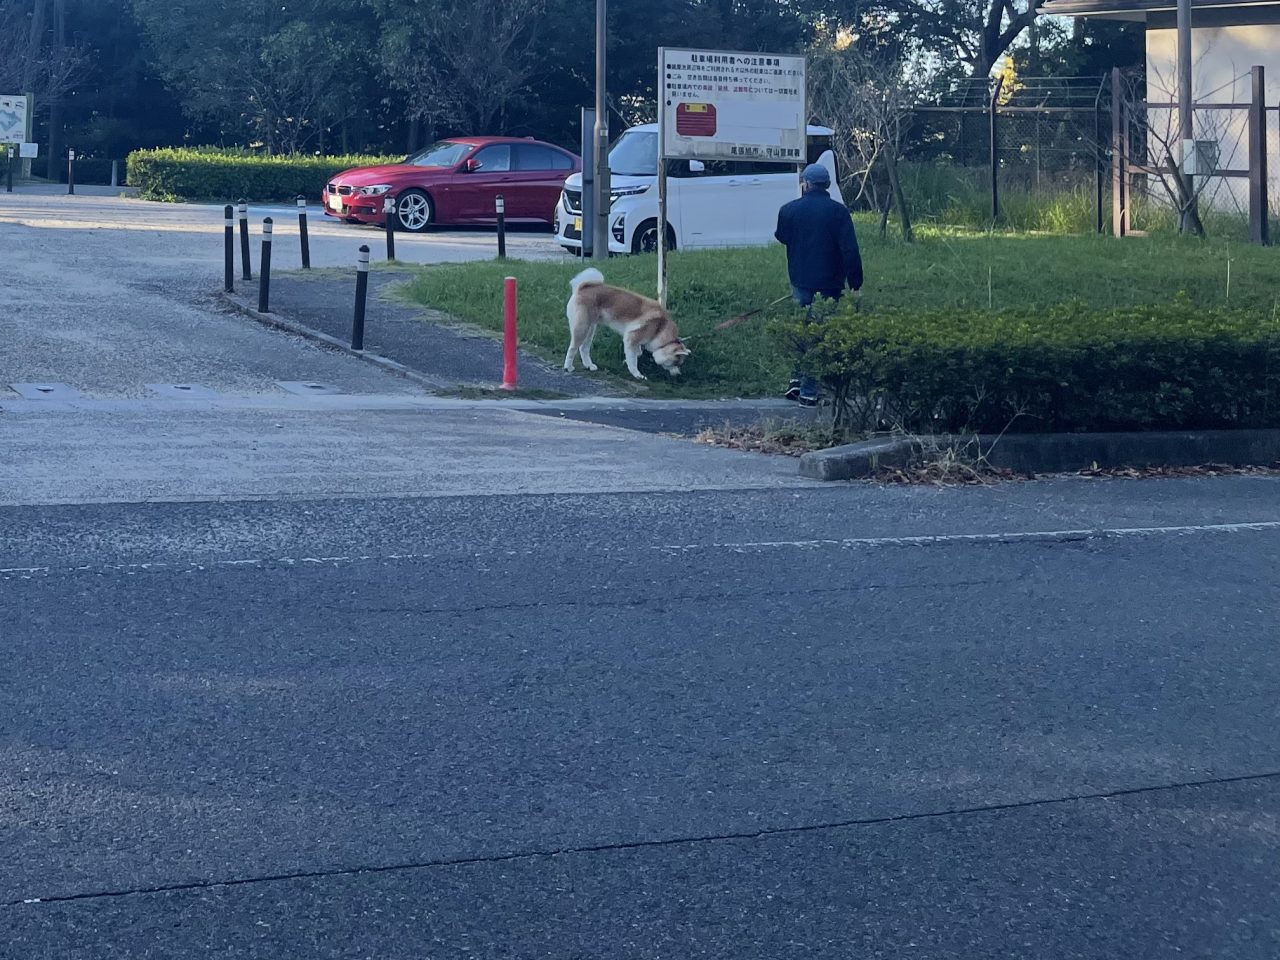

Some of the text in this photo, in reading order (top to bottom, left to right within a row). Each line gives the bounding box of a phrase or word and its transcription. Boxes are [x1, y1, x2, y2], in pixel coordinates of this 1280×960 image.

[691, 54, 780, 67] 駐車場利用者への注意事項
